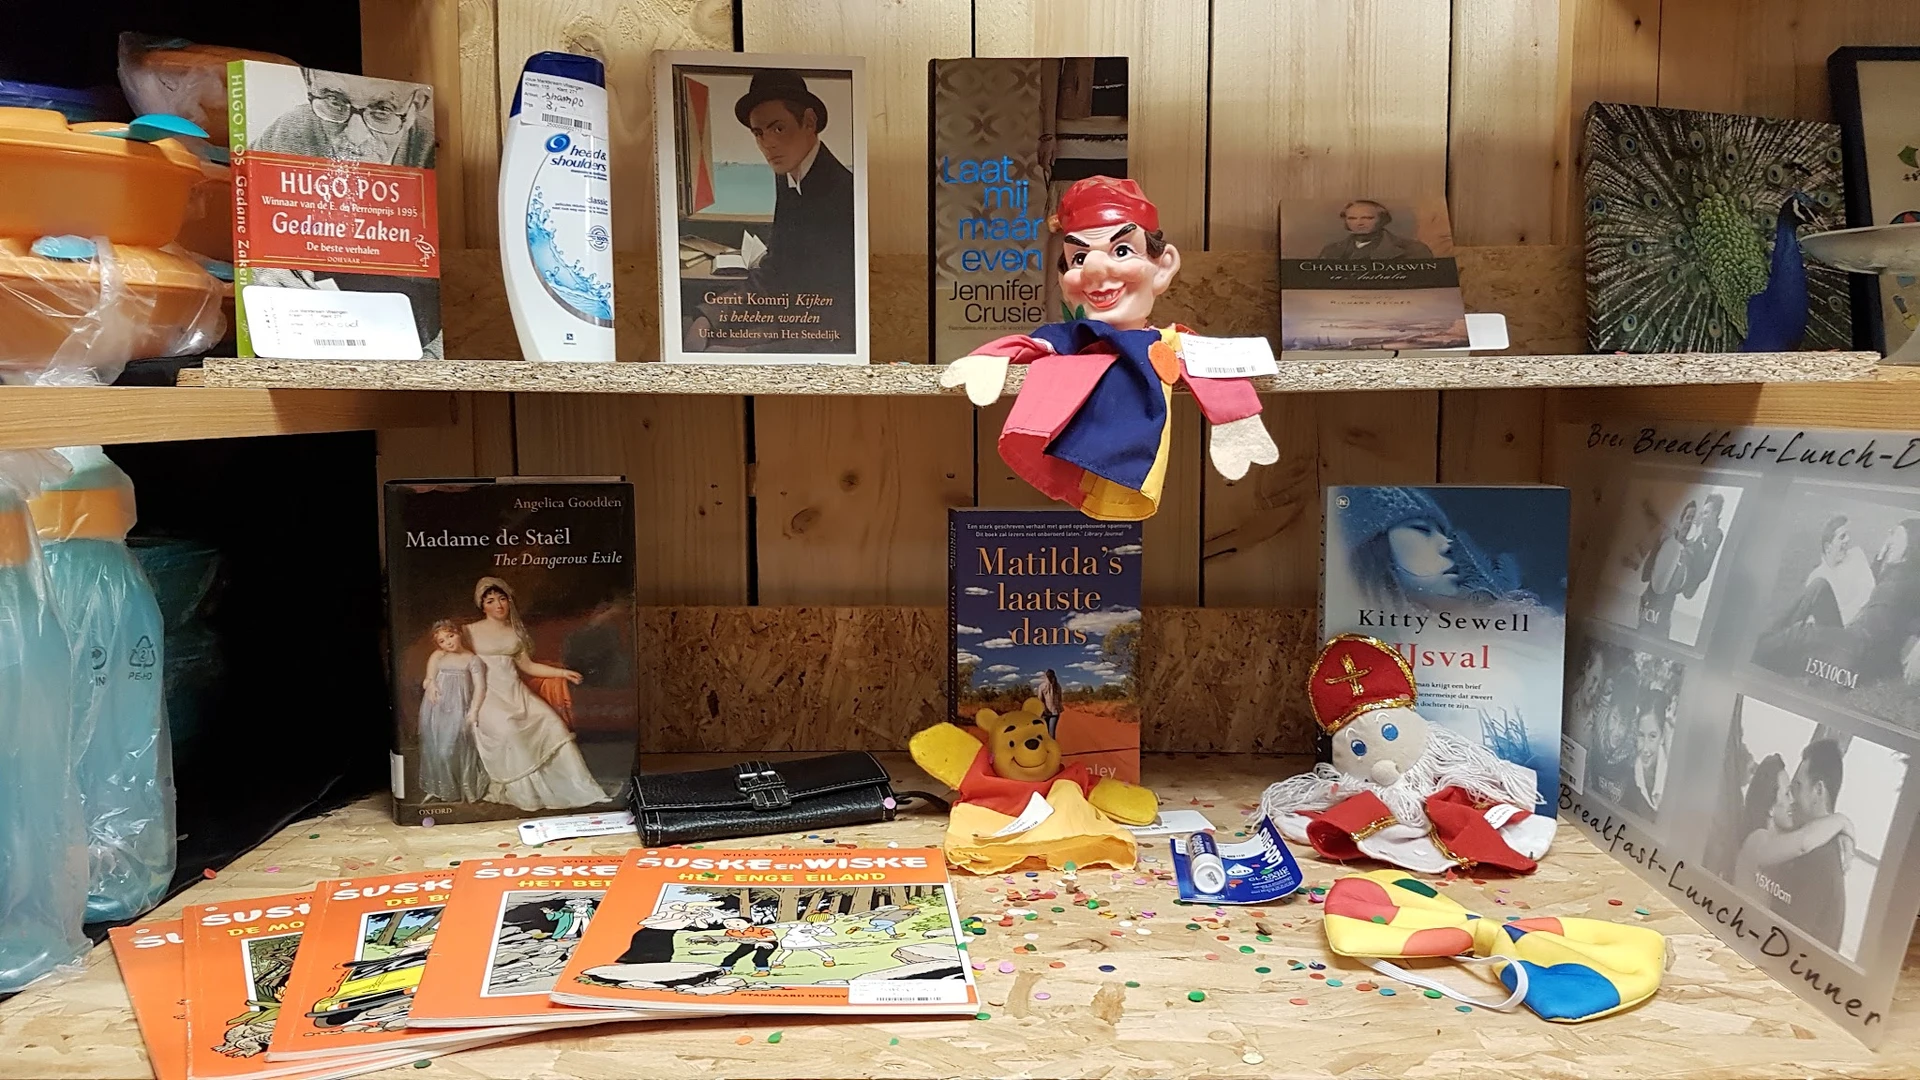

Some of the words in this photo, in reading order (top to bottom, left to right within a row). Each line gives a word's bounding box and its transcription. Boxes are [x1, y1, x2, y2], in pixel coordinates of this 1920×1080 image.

[231, 74, 243, 125] HUGO
[233, 133, 245, 166] POS
[550, 156, 606, 172] shoulders
[943, 156, 1014, 184] Laat
[280, 171, 348, 199] HUGO
[357, 179, 400, 203] POS
[236, 176, 248, 234] Gedane
[262, 196, 298, 207] Winnaar
[300, 200, 316, 209] van
[317, 200, 328, 210] de
[352, 204, 394, 218] Perronprijs
[397, 208, 418, 218] 1995
[984, 180, 1028, 218] mij
[272, 212, 346, 238] Gedane
[354, 218, 410, 243] Zaken
[958, 217, 1044, 240] maar
[306, 242, 319, 251] De
[320, 242, 343, 253] beste
[345, 244, 380, 256] verhalen
[238, 240, 250, 285] Zaken
[961, 248, 1042, 272] even
[1299, 262, 1368, 272] CHARLES
[1372, 262, 1438, 272] DARWIN
[949, 278, 1044, 300] Jennifer
[704, 292, 742, 305] Gerrit
[746, 292, 790, 309] Komrij
[795, 294, 833, 308] Kijken
[719, 310, 728, 322] is
[730, 310, 774, 322] bekeken
[778, 312, 820, 323] worden
[964, 302, 1042, 323] Crusie
[698, 328, 714, 338] Uit
[716, 329, 727, 338] de
[730, 329, 761, 338] kelders
[763, 331, 779, 339] van
[781, 330, 799, 339] Het
[801, 330, 840, 342] Stedelijk
[514, 497, 565, 512] Angelica
[568, 496, 622, 509] Goodden
[404, 530, 490, 548] Madame
[496, 528, 519, 546] de
[526, 528, 572, 546] Staël
[494, 553, 518, 566] The
[521, 552, 588, 570] Dangerous
[592, 551, 622, 564] Exile
[975, 546, 1124, 576] Matilda's
[996, 582, 1102, 612] laatste
[1010, 617, 1088, 646] dans
[1358, 609, 1429, 634] Kitty
[1438, 612, 1529, 632] Sewell
[1804, 656, 1860, 690] 15X10CM
[1418, 692, 1457, 700] ienermeisje
[1431, 682, 1450, 690] krijgt
[418, 807, 452, 816] OXFORD
[473, 864, 620, 879] SUSKE
[636, 857, 773, 870] SUSKE
[803, 856, 928, 870] WISKE
[518, 879, 565, 888] HET
[734, 874, 794, 882] ENGE
[805, 872, 886, 882] EILAND
[332, 879, 454, 900] SUSK
[1754, 872, 1792, 906] 15X10cm
[384, 896, 418, 907] DE
[227, 926, 260, 936] DE
[267, 920, 306, 932] MO
